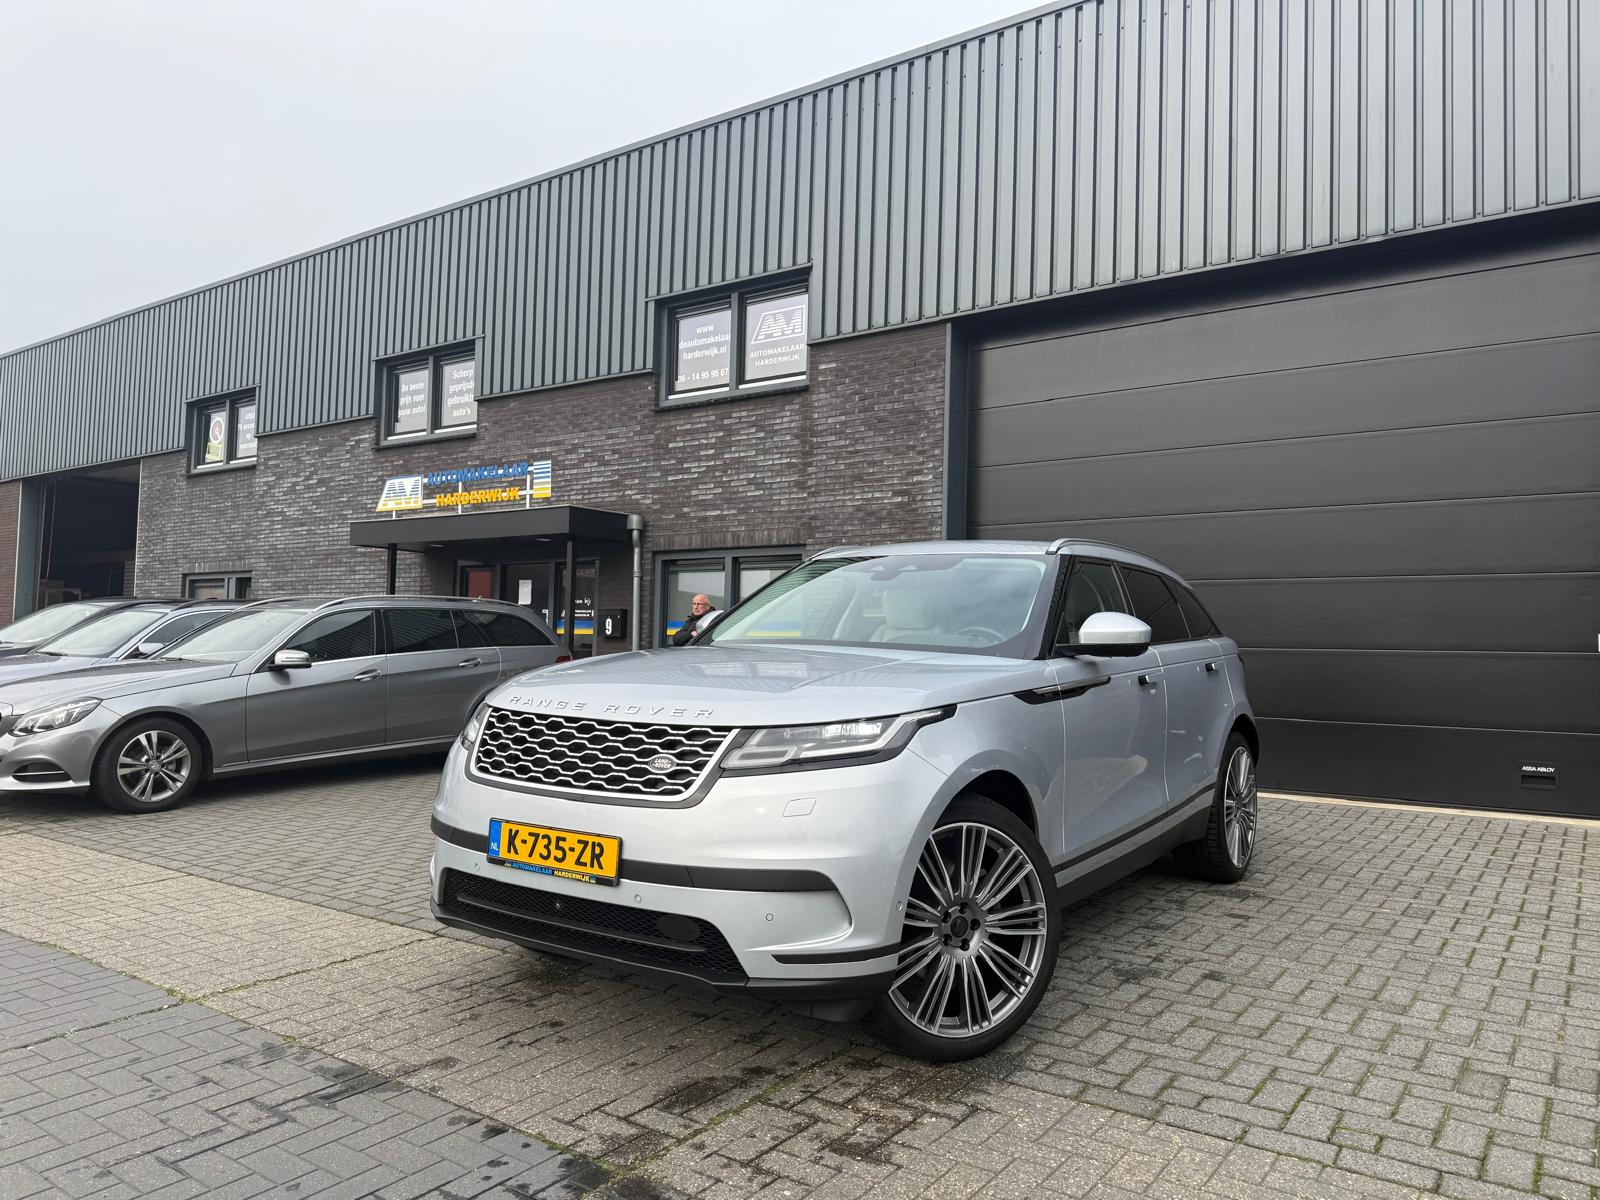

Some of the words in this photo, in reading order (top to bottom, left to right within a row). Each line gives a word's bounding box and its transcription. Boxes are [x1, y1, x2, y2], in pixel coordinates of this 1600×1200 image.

[696, 324, 714, 334] www
[683, 344, 727, 361] harderwijk.nl
[750, 343, 806, 358] AUTOMAKELAAR
[755, 353, 801, 367] HARDERWIJK
[452, 369, 473, 380] Scherp
[691, 371, 700, 382] 14
[700, 370, 710, 381] 95
[710, 368, 720, 379] 95
[720, 367, 730, 377] 67
[409, 381, 425, 391] beste
[452, 406, 471, 417] auto's
[427, 462, 529, 486] AUTOMAKELAAR
[435, 486, 521, 507] HARDERWIJK
[605, 618, 612, 635] 9
[508, 695, 588, 711] RANGE
[602, 704, 714, 719] ROVER
[490, 842, 499, 851] NL
[507, 828, 605, 870] K-735-ZR
[512, 862, 553, 875] AUTOMAKELAAR
[553, 869, 590, 882] HARDERWIJK
